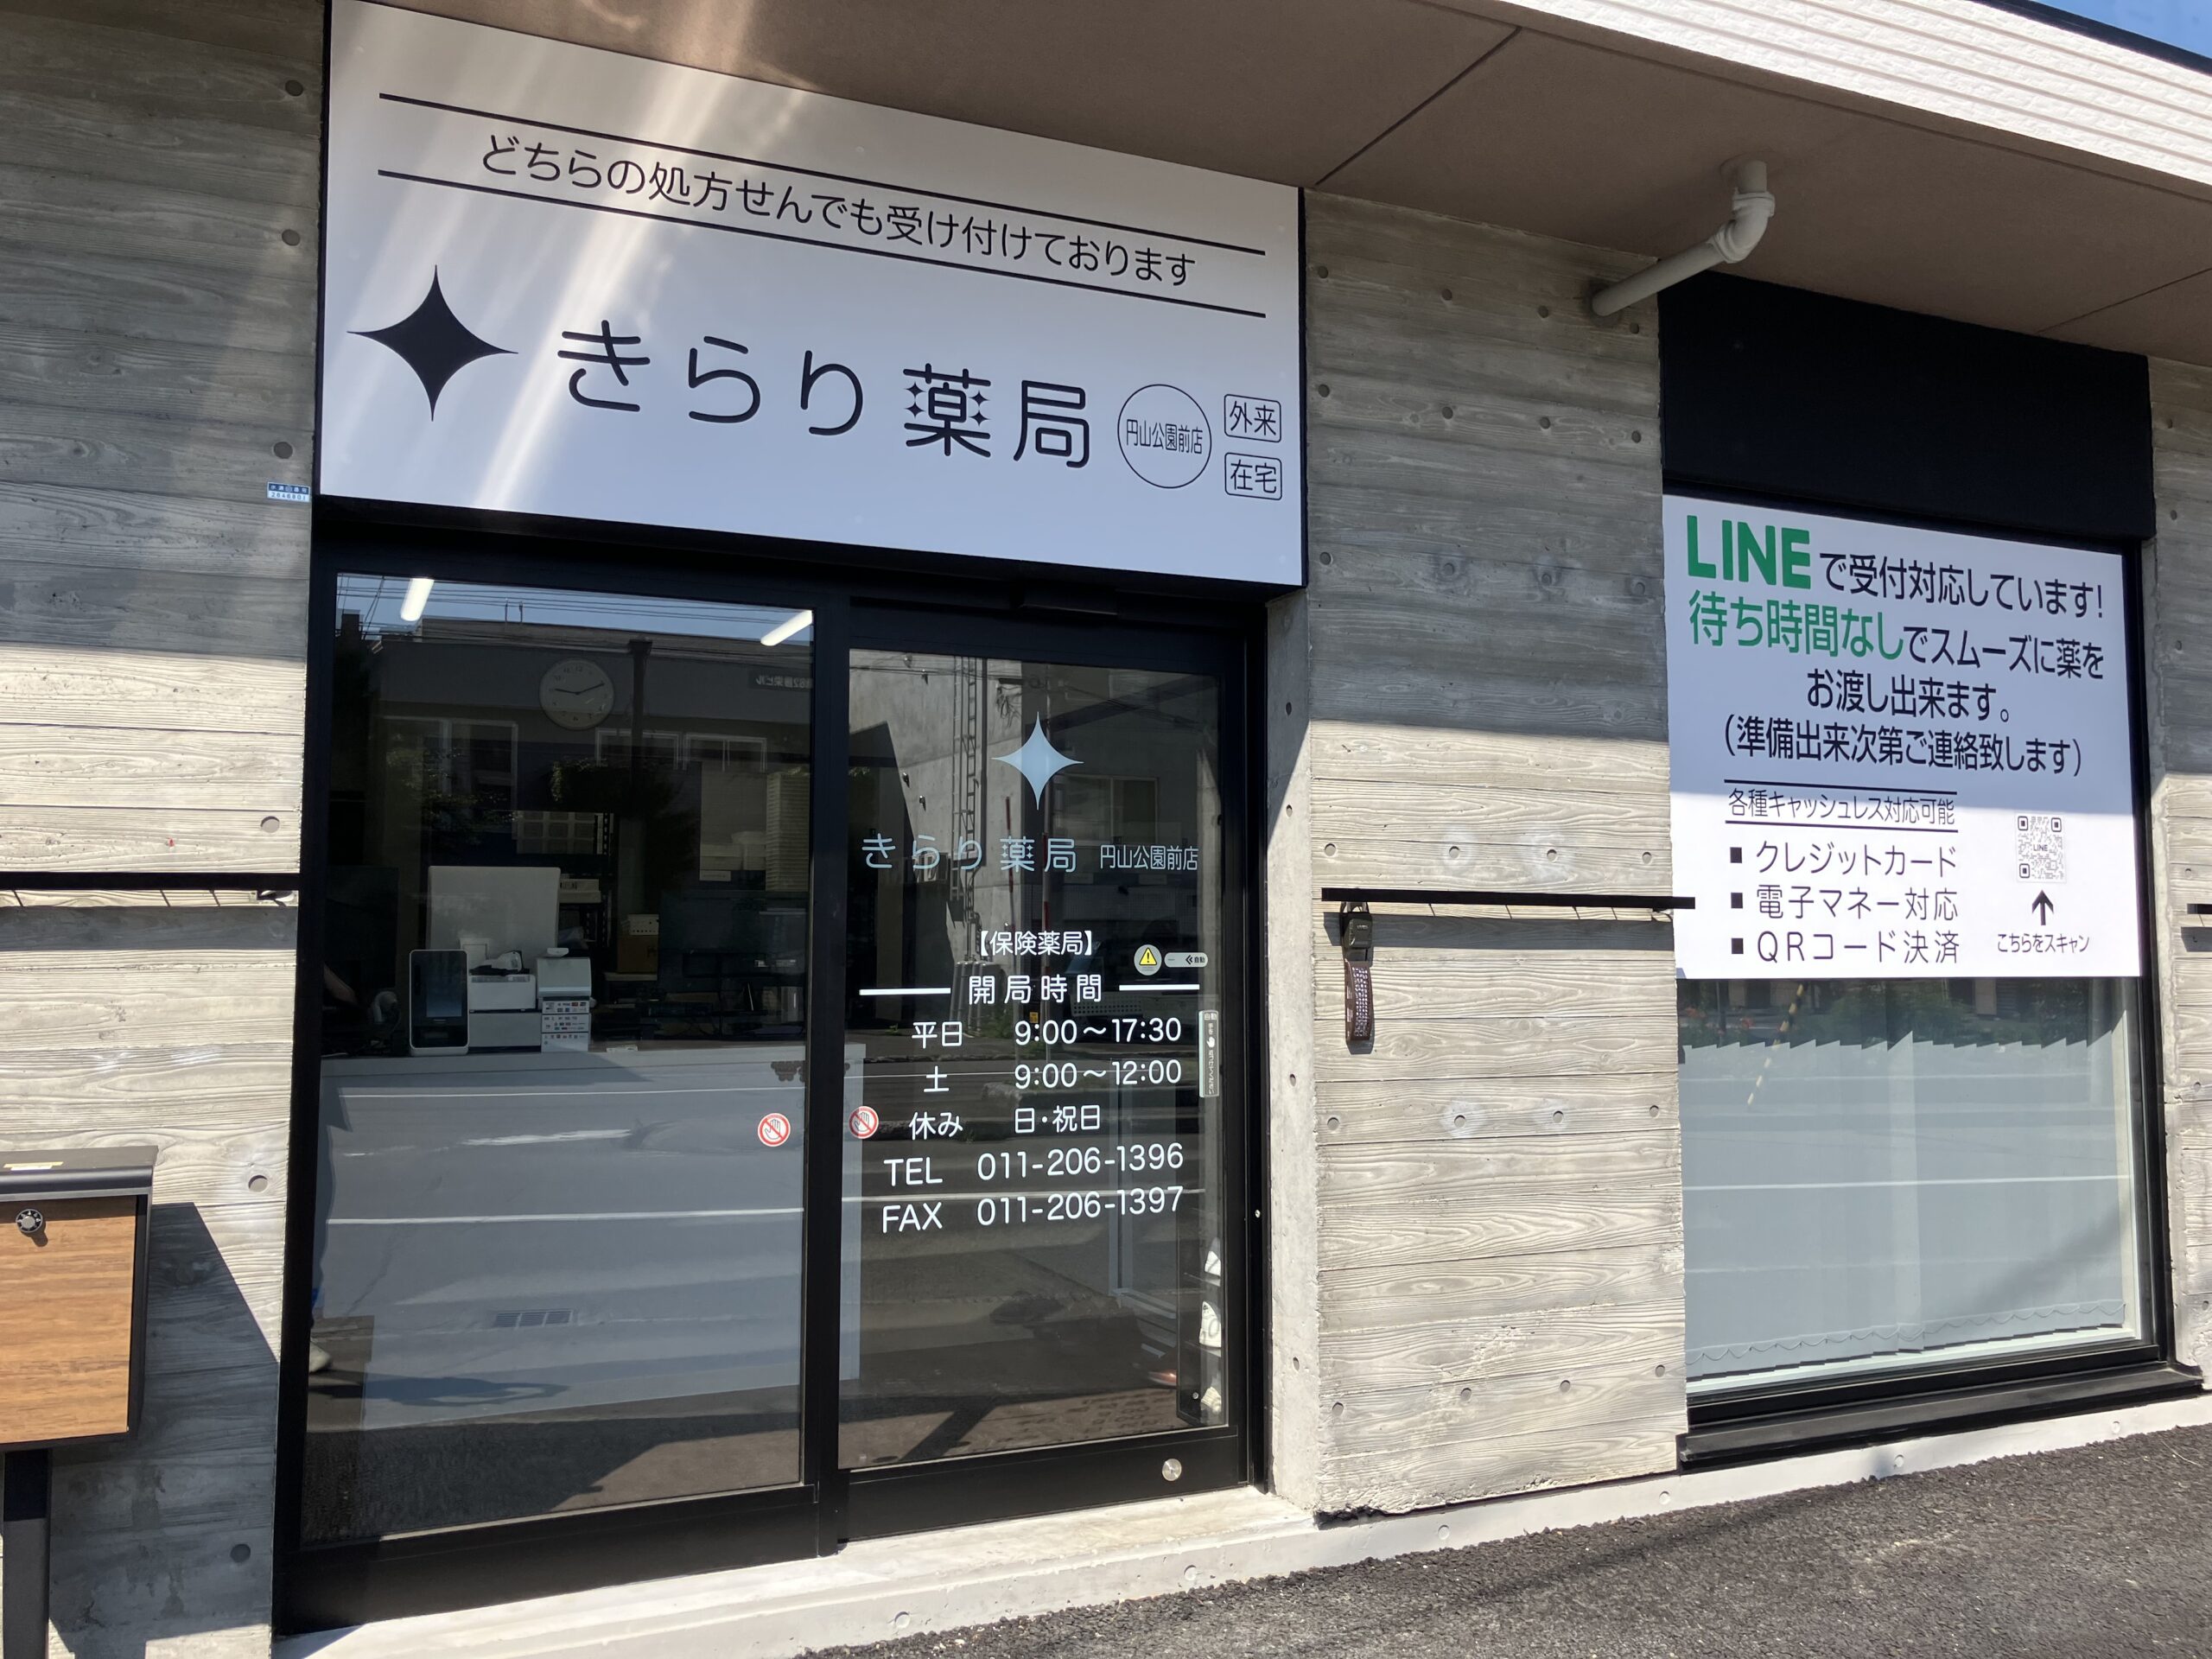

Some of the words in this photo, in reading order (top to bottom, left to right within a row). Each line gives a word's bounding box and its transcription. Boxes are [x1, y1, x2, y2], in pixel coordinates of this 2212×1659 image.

[483, 135, 1196, 285] どちらの処方せんでも受け付けております
[558, 320, 1090, 468] きらり薬局
[1126, 419, 1203, 454] 円山公園前店
[1229, 400, 1277, 437] 外来
[1230, 460, 1278, 493] 在宅
[1807, 669, 2010, 722] お渡し出来ます。
[1724, 714, 2081, 777] (準備出来次第ご連絡致します)
[1728, 788, 1955, 825] 各種キャッシュレス対応可能
[861, 833, 1077, 873] きらり薬局
[1100, 844, 1199, 871] 円山公園前店
[1756, 840, 1956, 877] クレジットカード
[1756, 884, 1959, 921] 電子マネー対応
[981, 931, 1091, 956] 【保険薬局】
[1757, 931, 1960, 964] QRコード決済
[1997, 932, 2090, 954] こちらをスキャン
[969, 974, 1103, 1004] 開局時間
[912, 1020, 963, 1049] 平日
[923, 1065, 950, 1093] 土
[908, 1111, 963, 1141] 休み
[1014, 1104, 1101, 1134] 日・祝日
[884, 1157, 943, 1186] TEL
[977, 1142, 1184, 1181] 011-206-1396
[882, 1202, 943, 1233] FAX
[977, 1185, 1184, 1226] 011-206-1397
